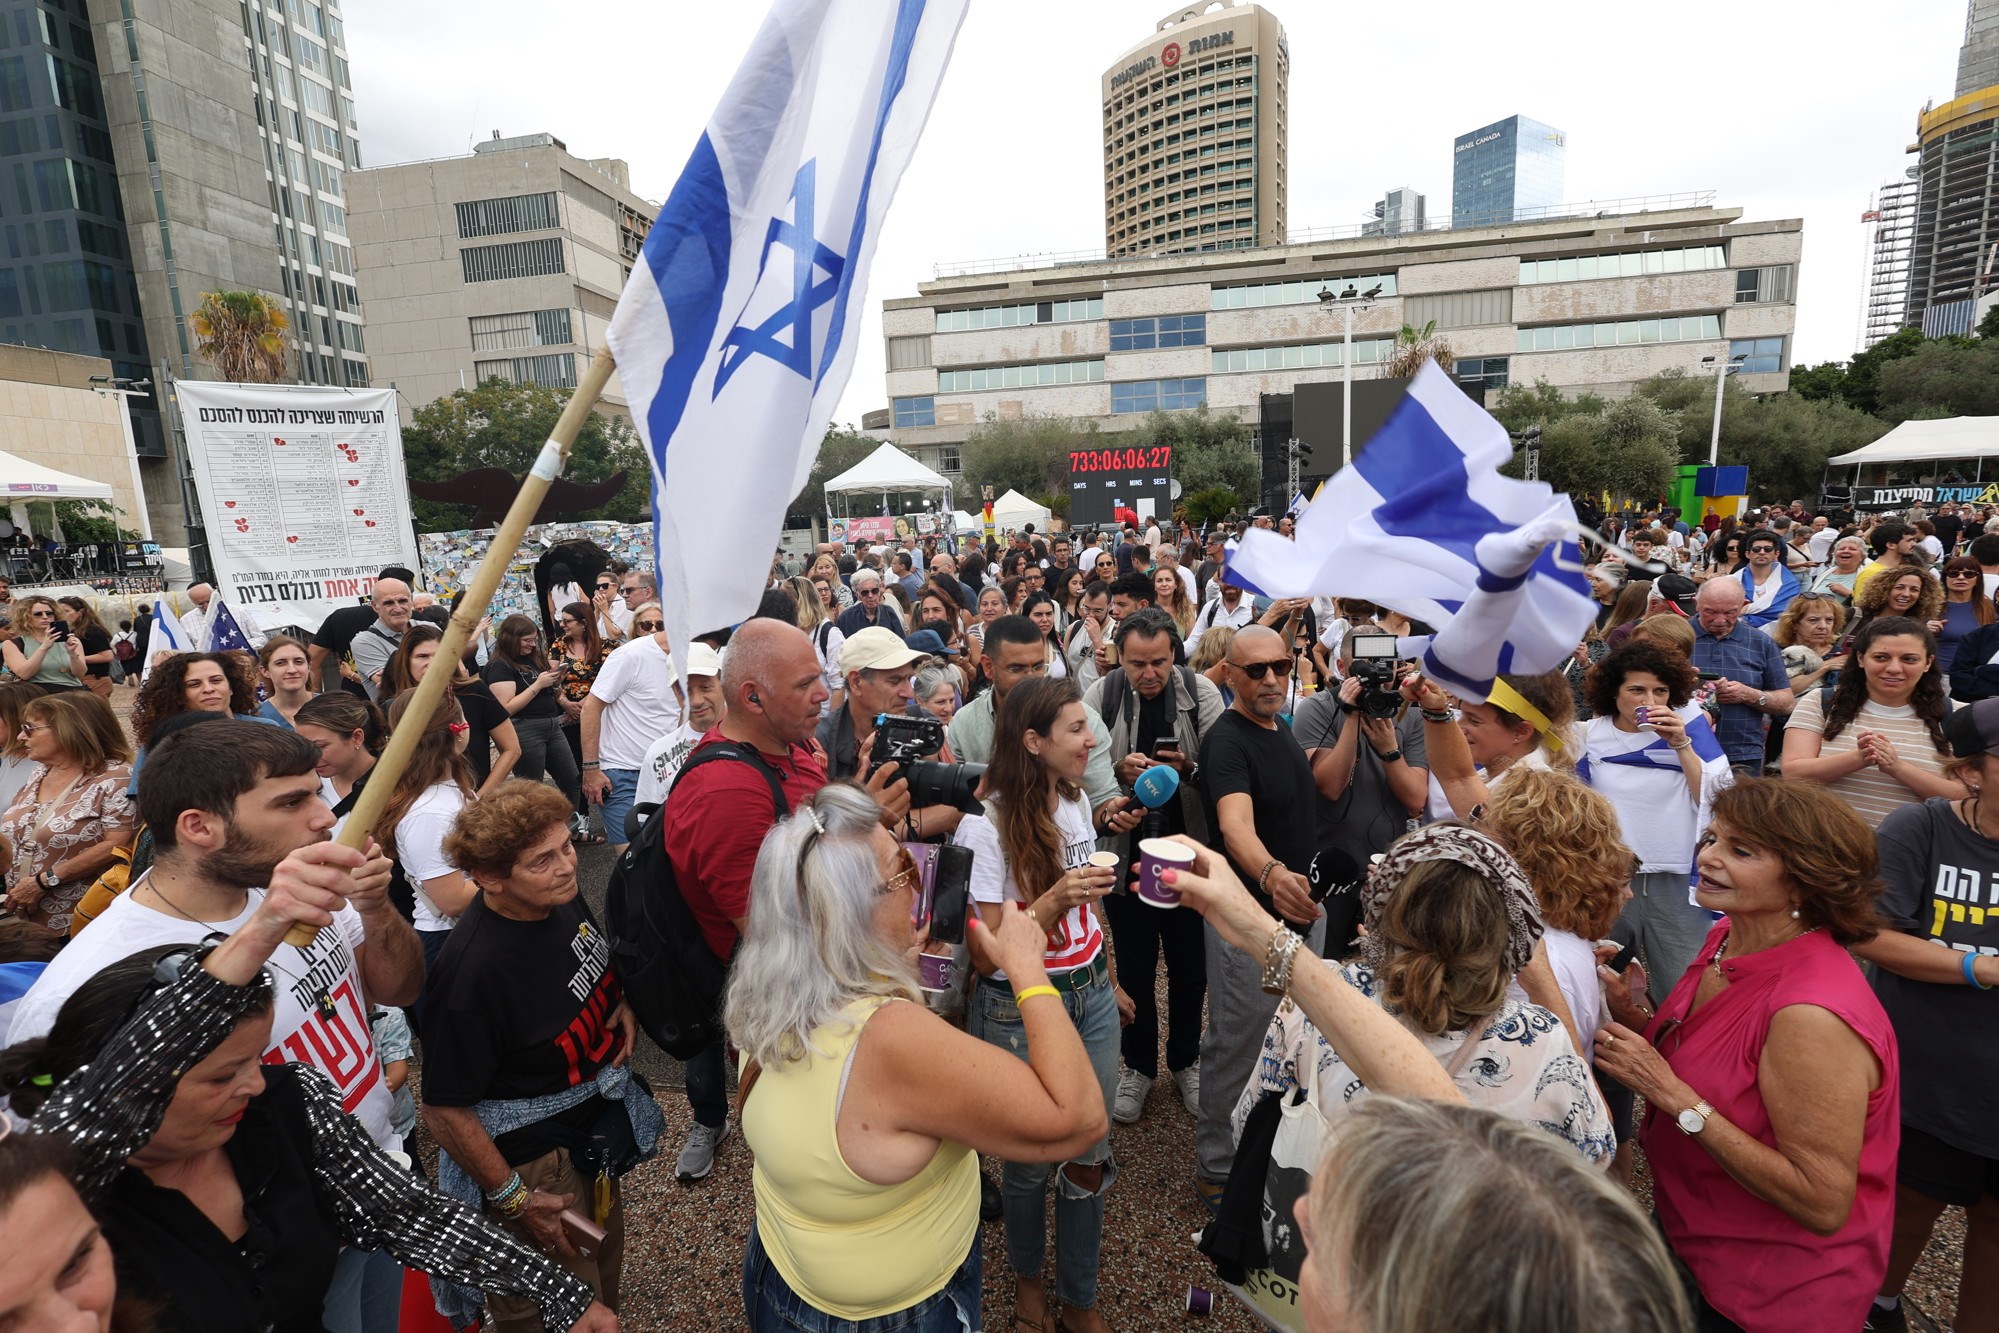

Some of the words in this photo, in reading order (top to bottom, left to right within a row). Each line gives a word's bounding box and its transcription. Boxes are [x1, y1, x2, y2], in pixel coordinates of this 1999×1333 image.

[1188, 30, 1234, 54] אמות
[1110, 54, 1156, 90] השקעות
[1455, 141, 1475, 153] ISRAEL
[1475, 132, 1501, 146] CANADA
[199, 407, 243, 423] להסכם
[246, 408, 285, 424] להכנס
[289, 409, 336, 424] שצריכה
[338, 410, 384, 424] הרשימה
[1070, 447, 1171, 472] 733:06:06:27
[1105, 480, 1117, 488] HRS
[1872, 486, 1934, 505] מתייצבת
[1936, 486, 1984, 503] ישראל
[275, 572, 289, 581] היא
[311, 568, 331, 577] לחזור
[332, 567, 354, 579] שצריך
[355, 565, 379, 574] היחידה
[236, 582, 277, 605] בבית
[278, 579, 322, 602] וכולם
[324, 579, 361, 599] אחת
[1144, 778, 1160, 797] NRK
[1934, 863, 1981, 903] הם
[567, 955, 605, 1003] הביתה
